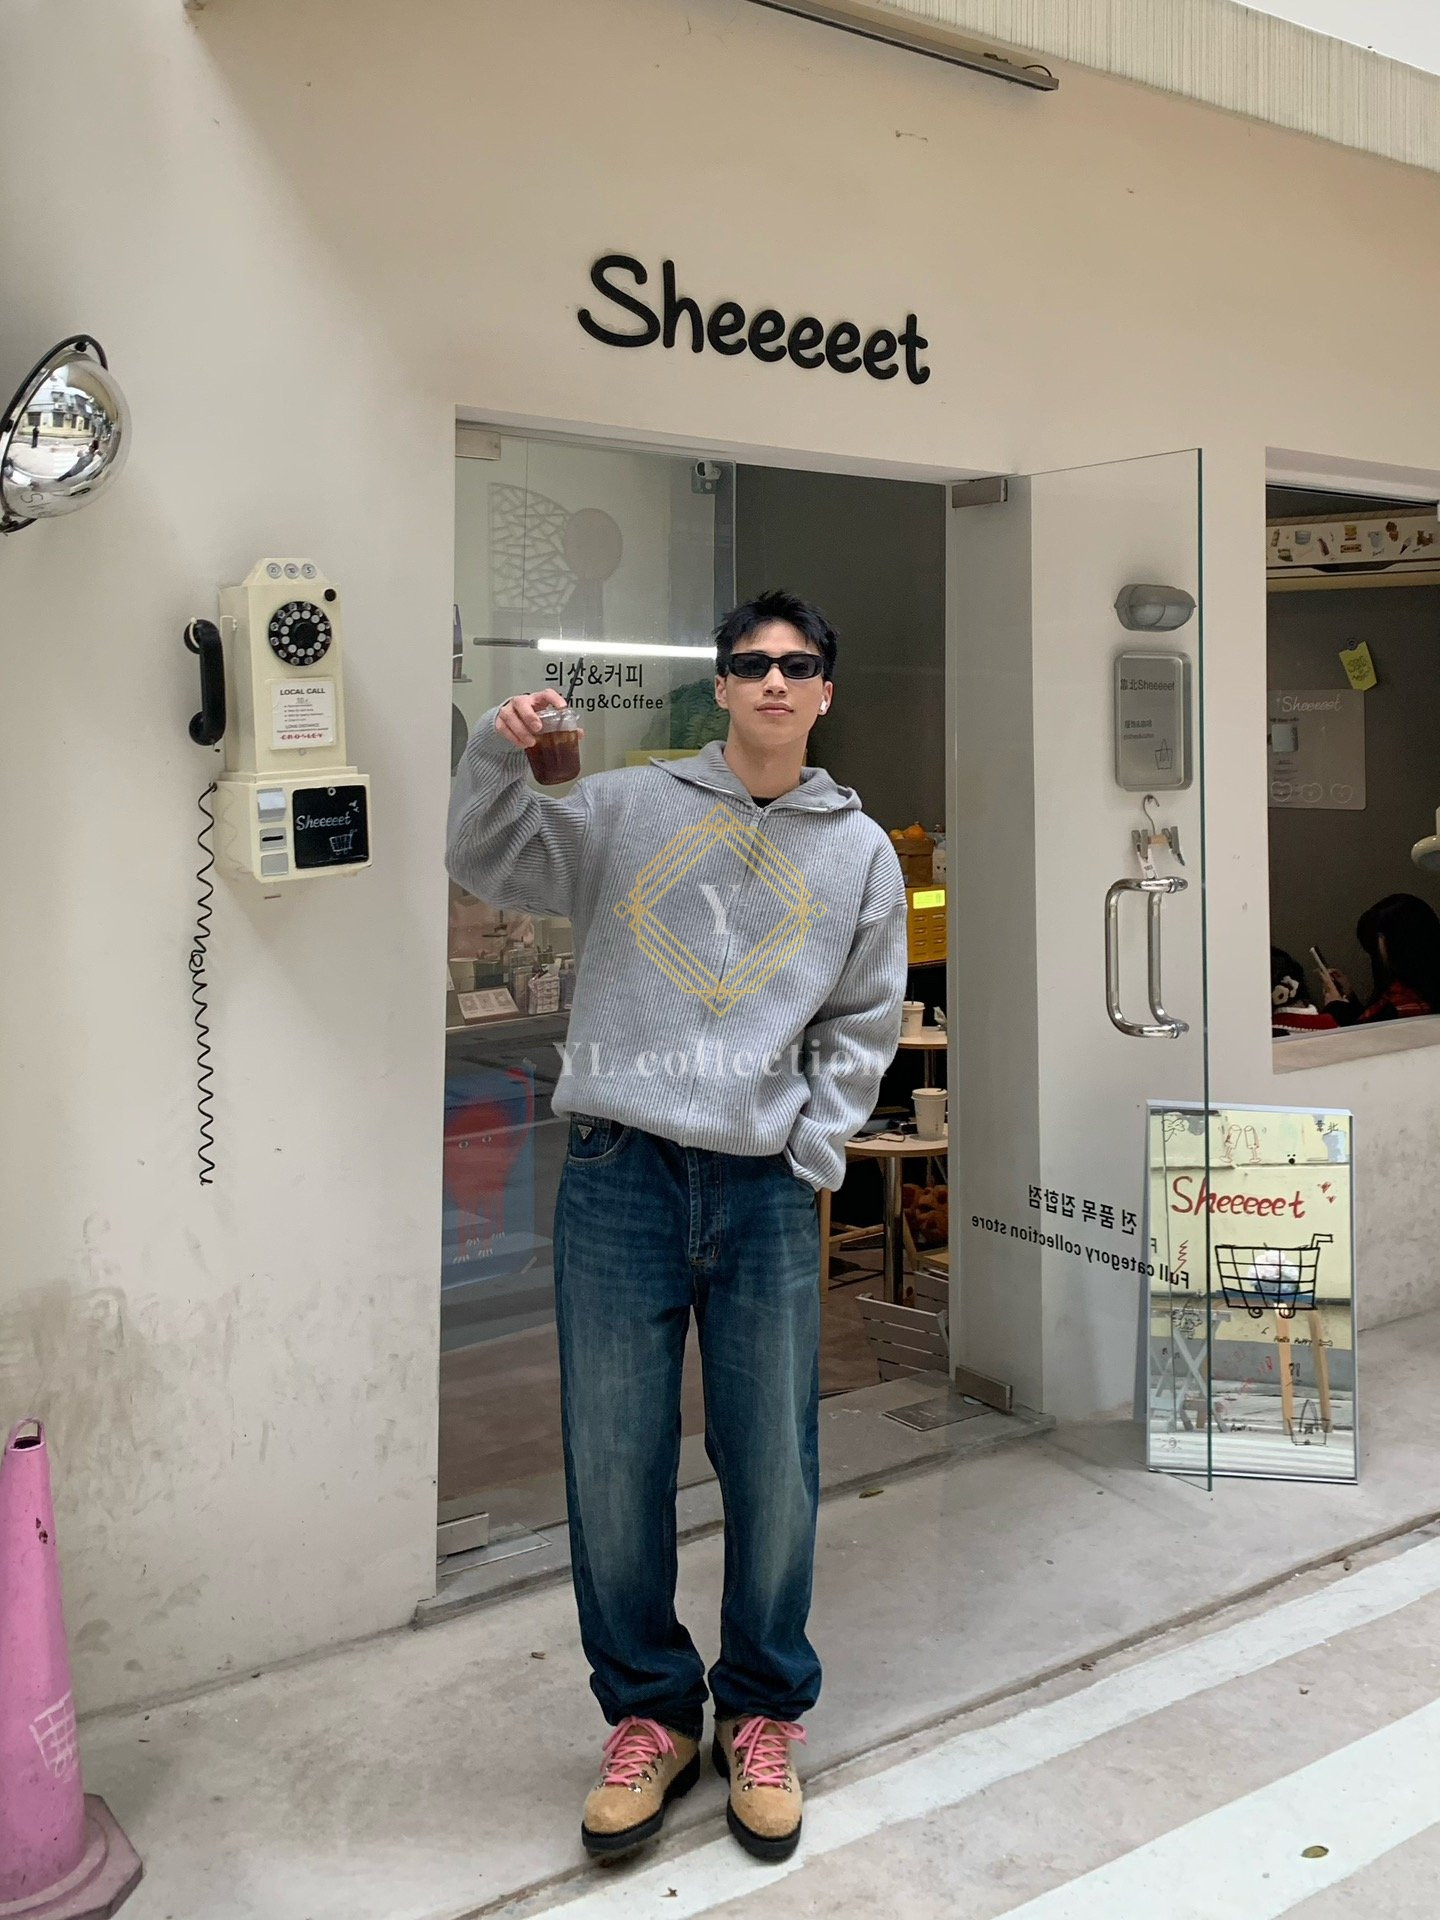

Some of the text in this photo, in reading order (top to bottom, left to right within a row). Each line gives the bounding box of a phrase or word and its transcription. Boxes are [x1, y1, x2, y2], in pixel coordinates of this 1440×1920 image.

[577, 255, 931, 385] Sheeeeet
[545, 661, 643, 688] 의상&커피
[280, 687, 326, 696] LOCAL CALL
[295, 811, 352, 831] Sheeeeet
[1171, 1175, 1306, 1219] Sheeeeet
